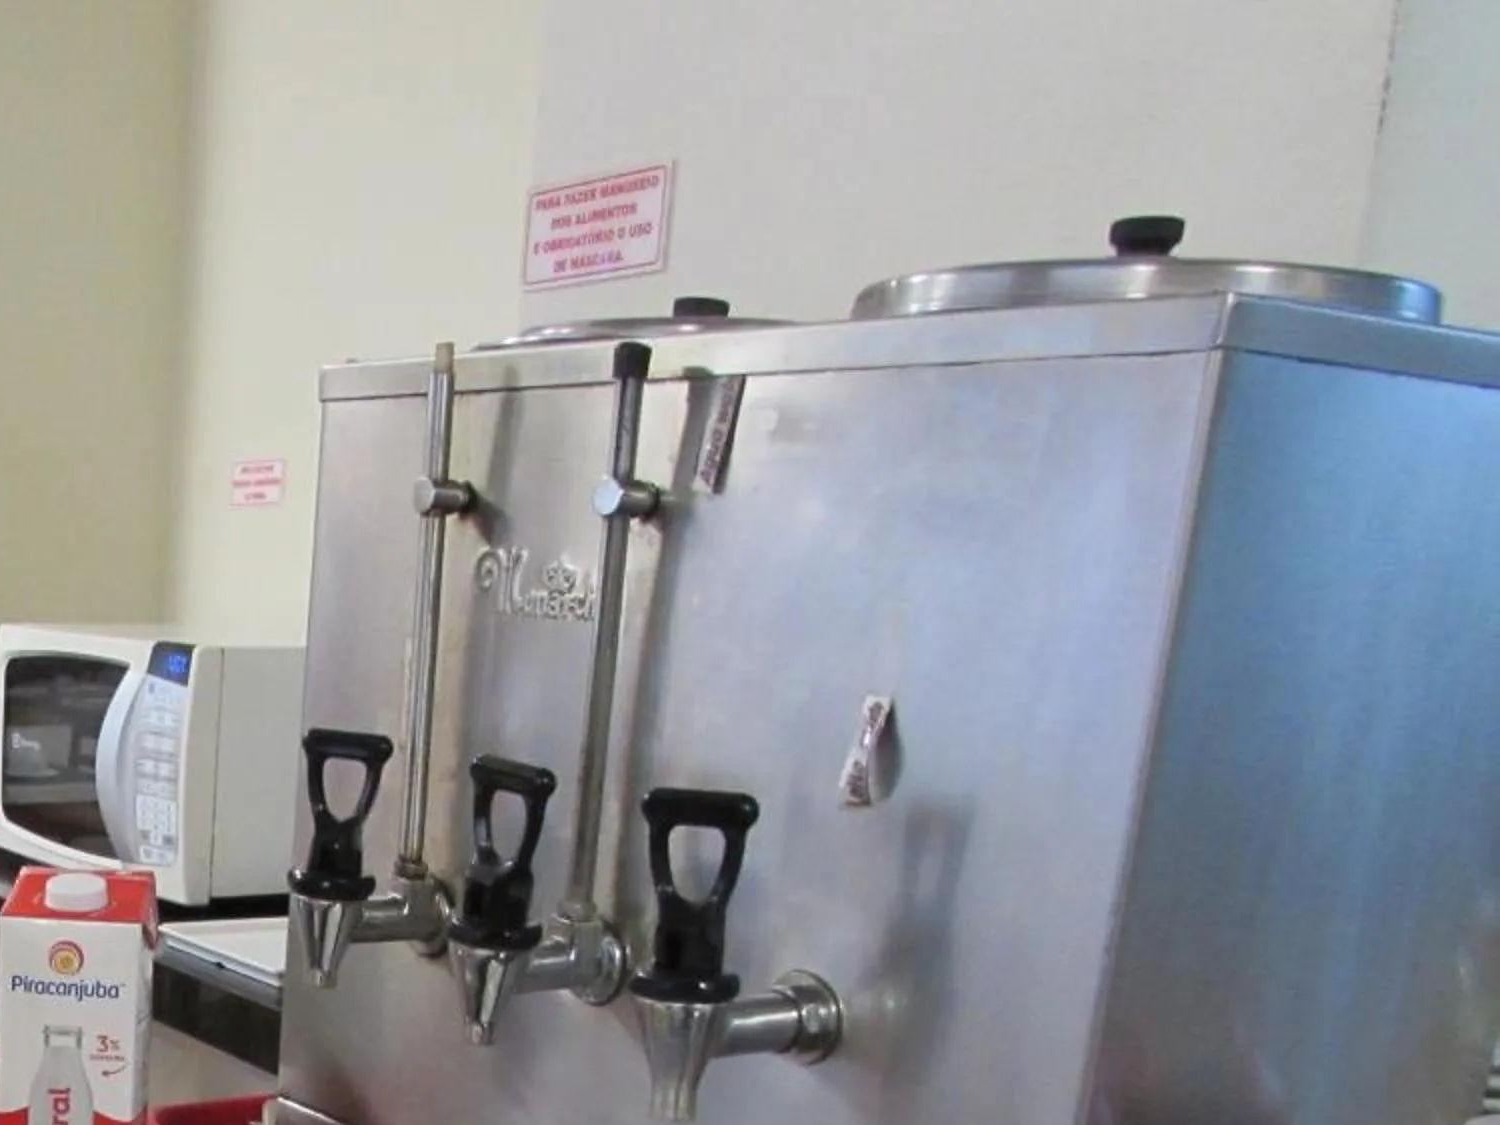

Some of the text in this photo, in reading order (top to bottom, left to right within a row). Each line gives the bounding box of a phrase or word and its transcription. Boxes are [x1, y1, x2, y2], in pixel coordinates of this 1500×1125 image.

[575, 203, 637, 225] ALIMENTOS
[629, 222, 654, 238] USO
[11, 975, 119, 1002] Piracanjuba
